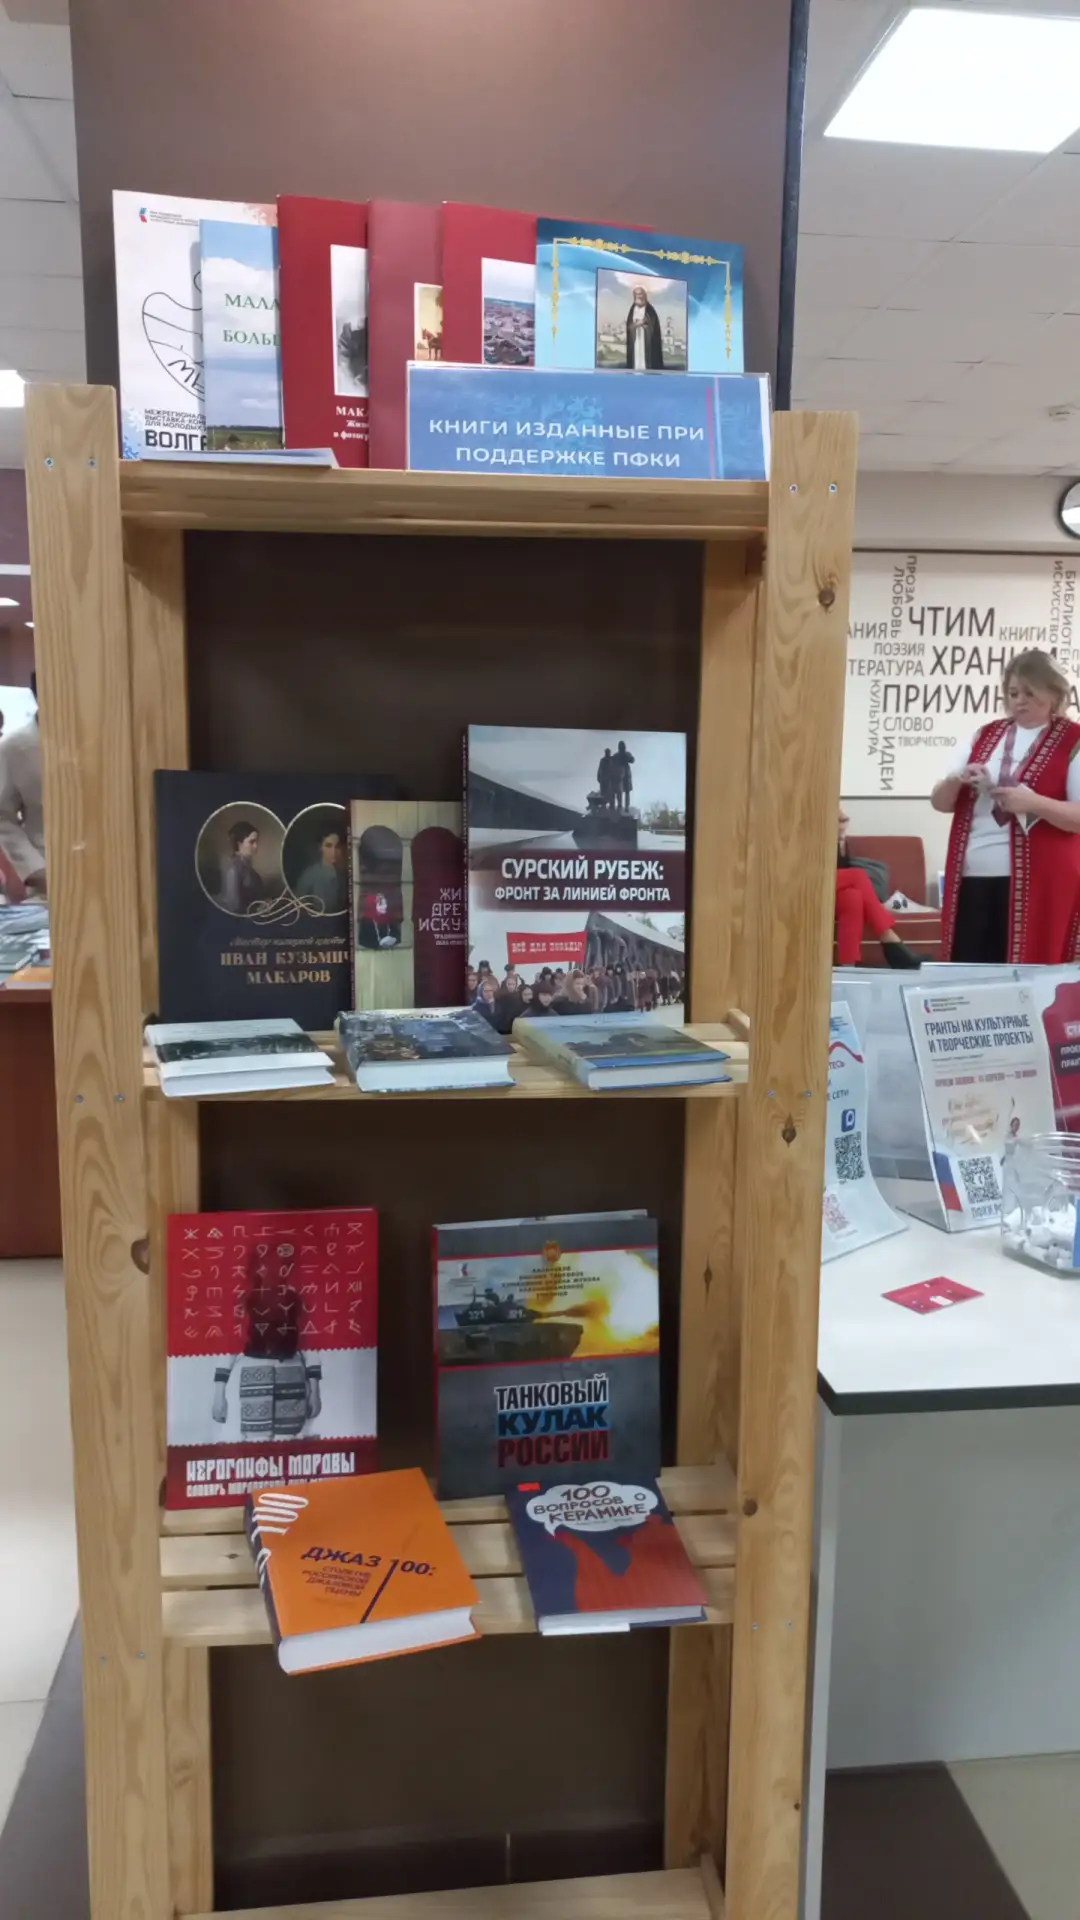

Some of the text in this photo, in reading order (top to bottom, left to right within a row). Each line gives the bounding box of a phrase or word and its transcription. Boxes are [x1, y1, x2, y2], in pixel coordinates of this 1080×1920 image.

[429, 419, 705, 441] КНИГИ ИЗДАННЫЕ ПРИ
[455, 447, 681, 467] ПОДДЕРЖКЕ ПФКИ
[905, 555, 917, 604] ПРОЗА
[891, 566, 904, 638] ЛЮБОВЬ
[1050, 560, 1063, 643] ИСКУССТВО
[909, 606, 995, 637] ЧТИМ
[999, 626, 1047, 641] КНИГИ
[874, 642, 925, 656] ПОЭЗИЯ
[867, 679, 882, 756] КУЛЬТУРА
[883, 717, 933, 732] СЛОВО
[899, 736, 957, 747] ТВОРЧЕСТВО
[880, 736, 896, 791] ИДЕИ
[501, 855, 664, 881] СУРСКИЙ РУБЕЖ:
[495, 884, 671, 901] ФРОНТ ЗА ЛИНИЕЙ ФРОНТА
[432, 902, 462, 918] ДРЕ
[419, 917, 461, 932] ИСКУ
[220, 952, 268, 966] ИВАН
[246, 970, 332, 984] МАКАРОВ
[924, 1014, 1030, 1036] ГРАНТЫ НА КУЛЬТУРНЫЕ
[928, 1031, 1034, 1053] И ТВОРЧЕСКИЕ ПРОЕКТЫ
[832, 1089, 849, 1100] СЕТИ
[494, 1373, 609, 1411] ТАНКОВЫЙ
[498, 1404, 609, 1437] КУЛАК
[498, 1430, 609, 1468] РОССИИ
[186, 1451, 355, 1482] ИЕРОГЛИФЫ МОРДВЫ
[534, 1492, 646, 1515] ВОПРОСОВ О
[561, 1485, 610, 1502] 100
[549, 1503, 647, 1524] КЕРАМИКЕ
[300, 1546, 382, 1567] ДЖАЗ
